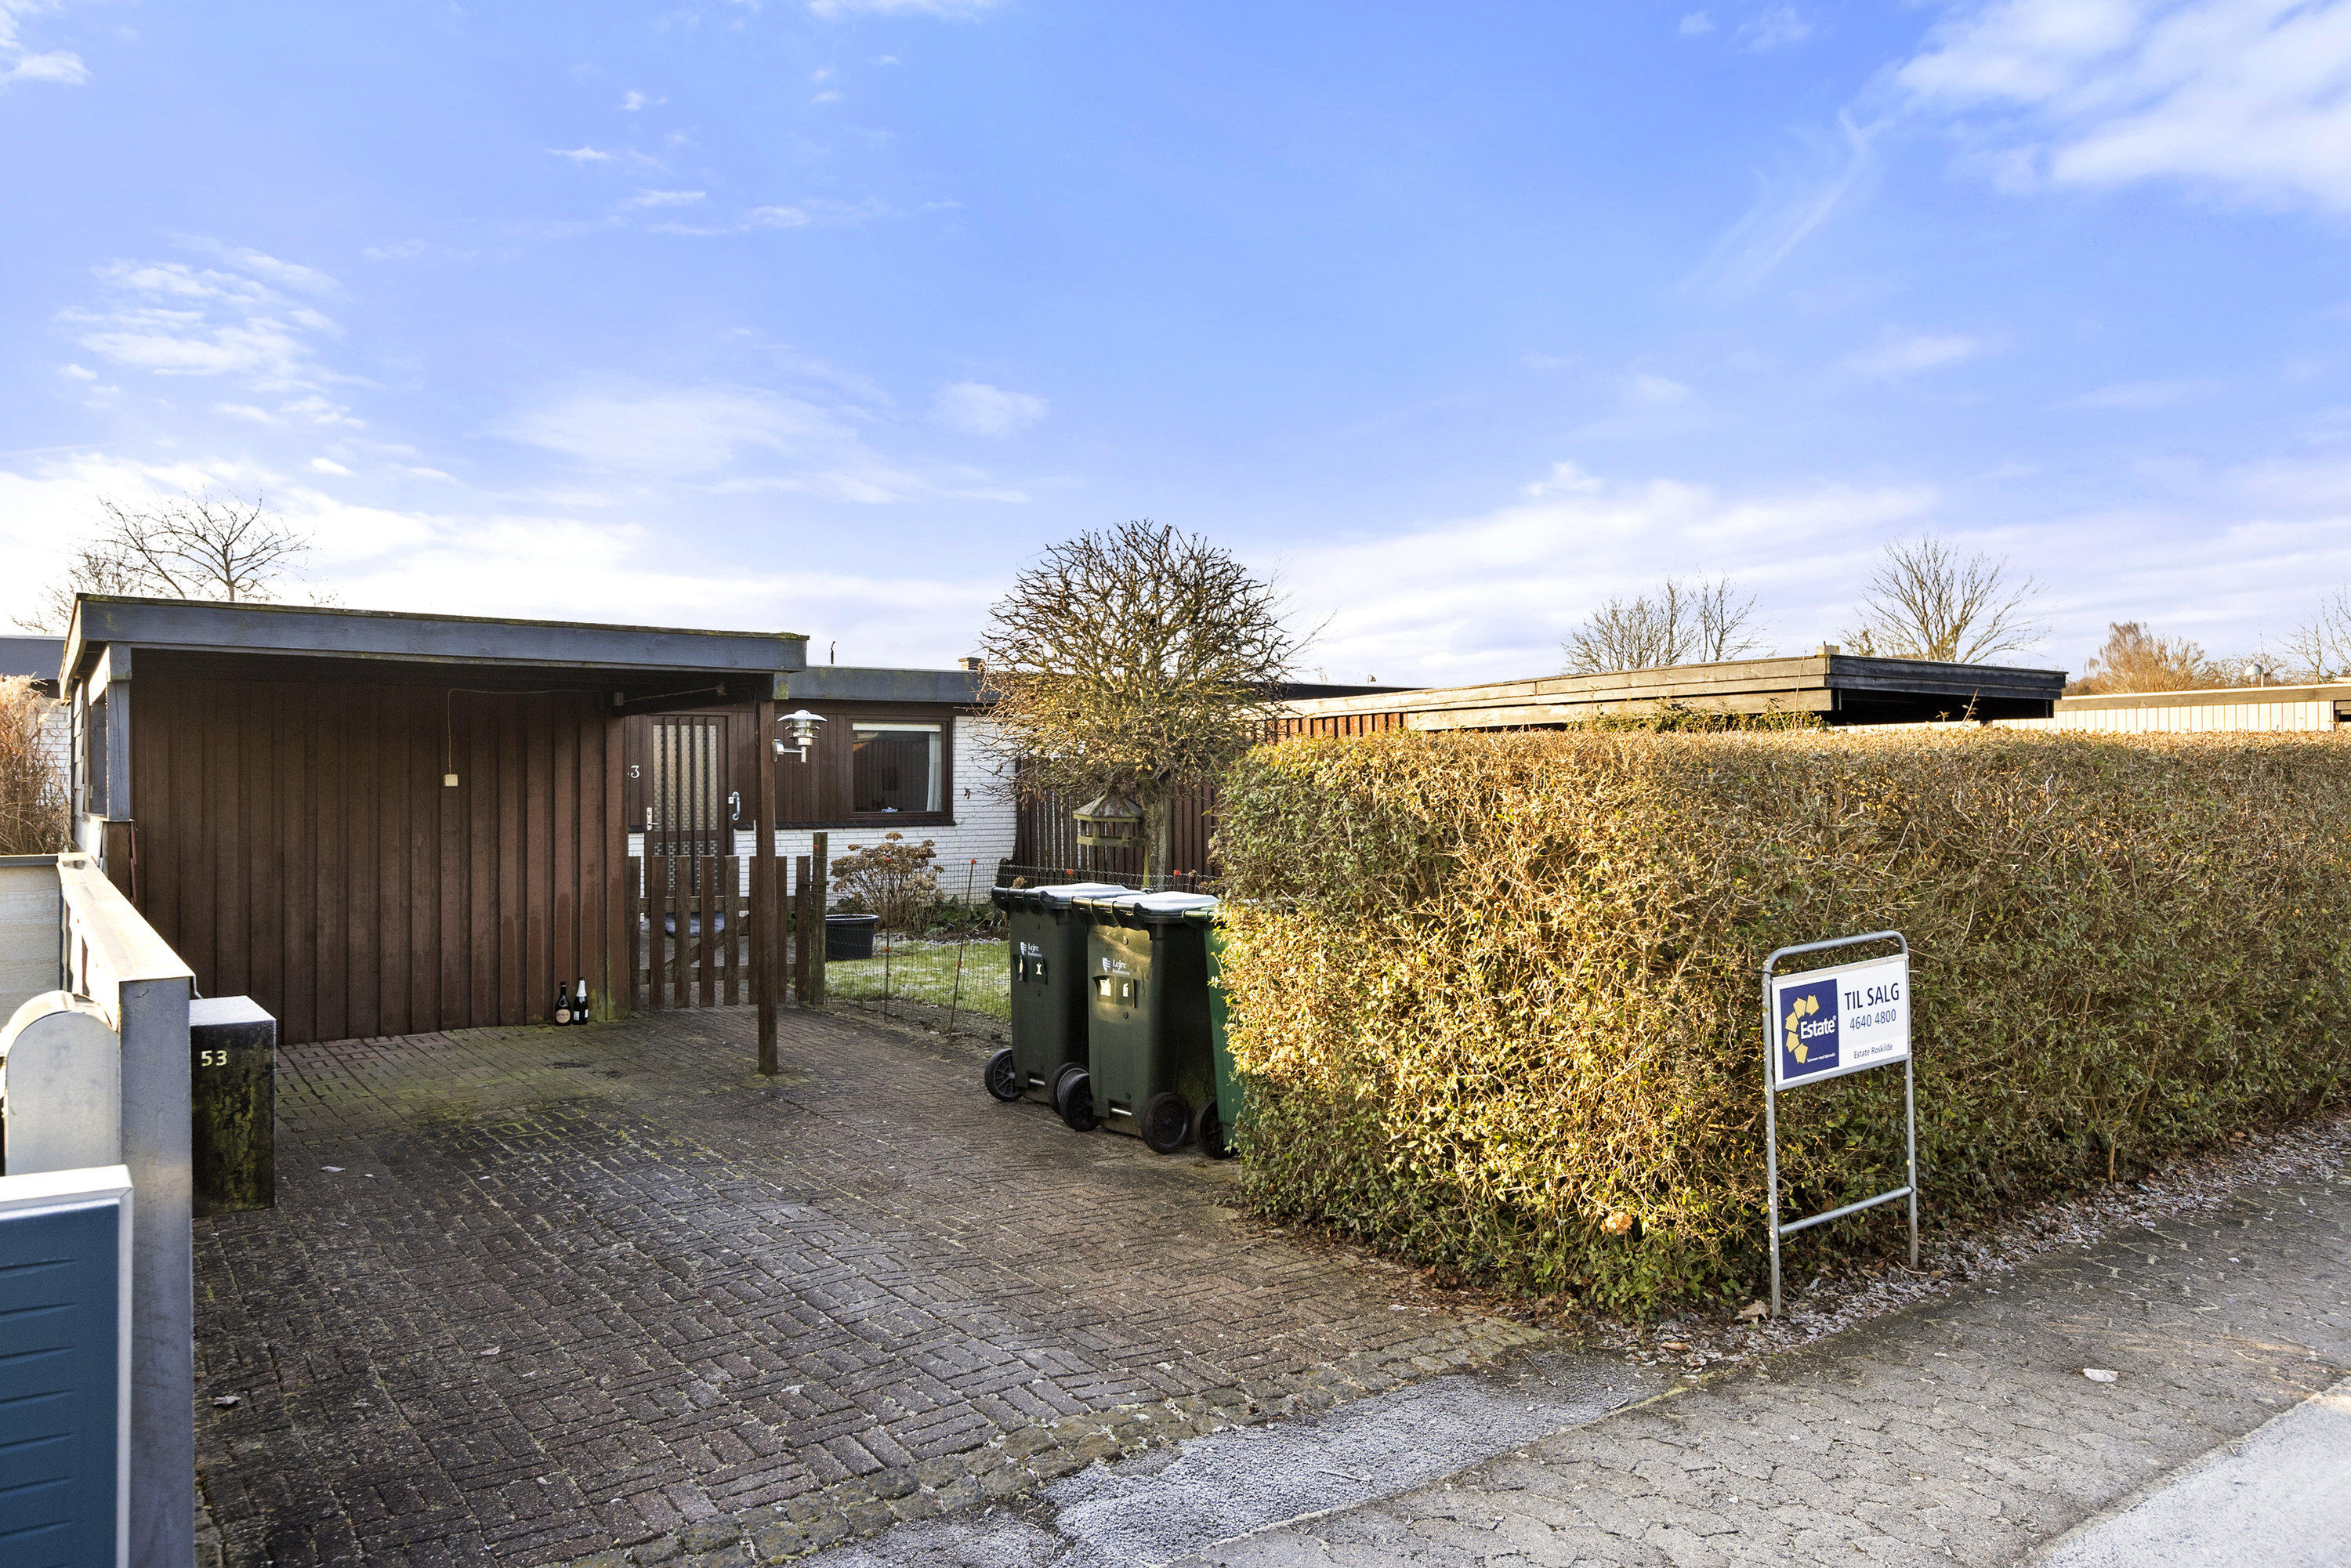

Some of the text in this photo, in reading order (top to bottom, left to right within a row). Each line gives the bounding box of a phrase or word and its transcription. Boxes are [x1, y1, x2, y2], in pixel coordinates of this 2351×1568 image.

[1844, 983, 1900, 1011] TIL SALG
[1800, 1018, 1835, 1040] Estate
[1849, 1009, 1896, 1030] 4640 4800
[201, 1050, 227, 1066] 53
[1853, 1043, 1893, 1059] Estate Roskilde
